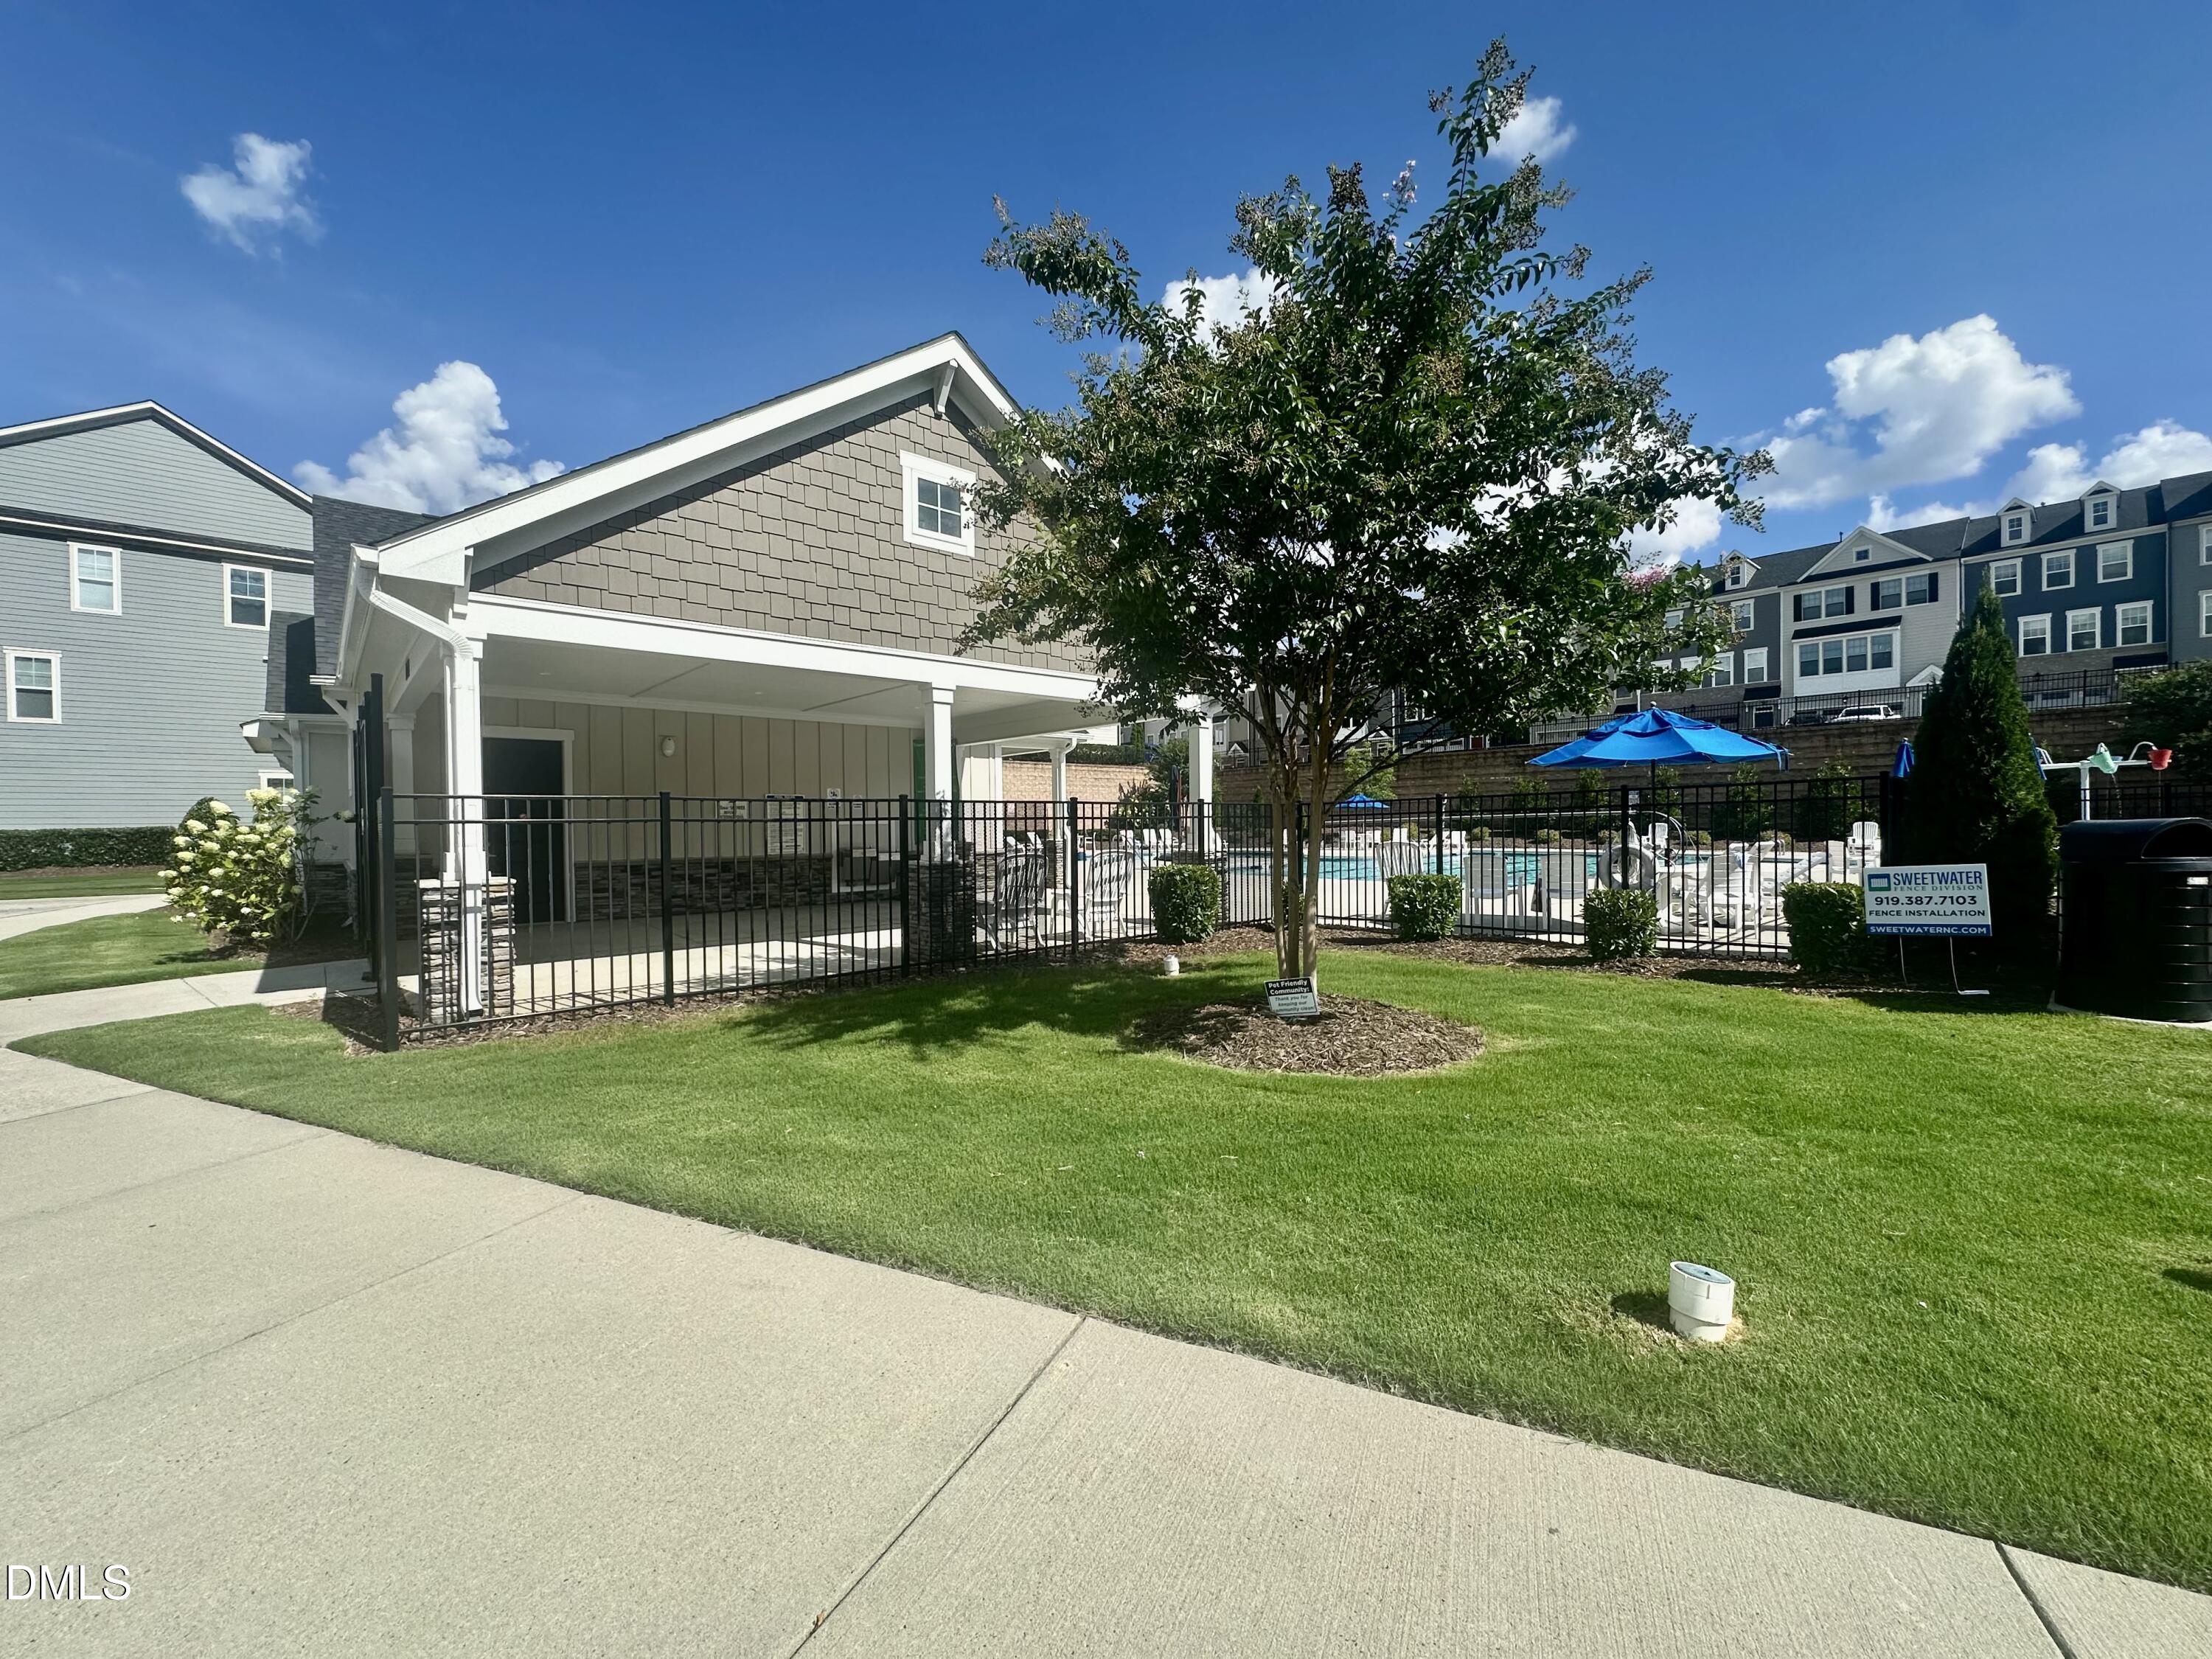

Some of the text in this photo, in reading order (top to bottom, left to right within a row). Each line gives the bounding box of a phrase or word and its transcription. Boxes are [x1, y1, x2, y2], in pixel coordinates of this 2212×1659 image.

[1893, 871, 1983, 886] SWEETWATER
[1874, 895, 1978, 905] 919.387.7103
[1869, 926, 1987, 934] SWEETWATERNC.COM
